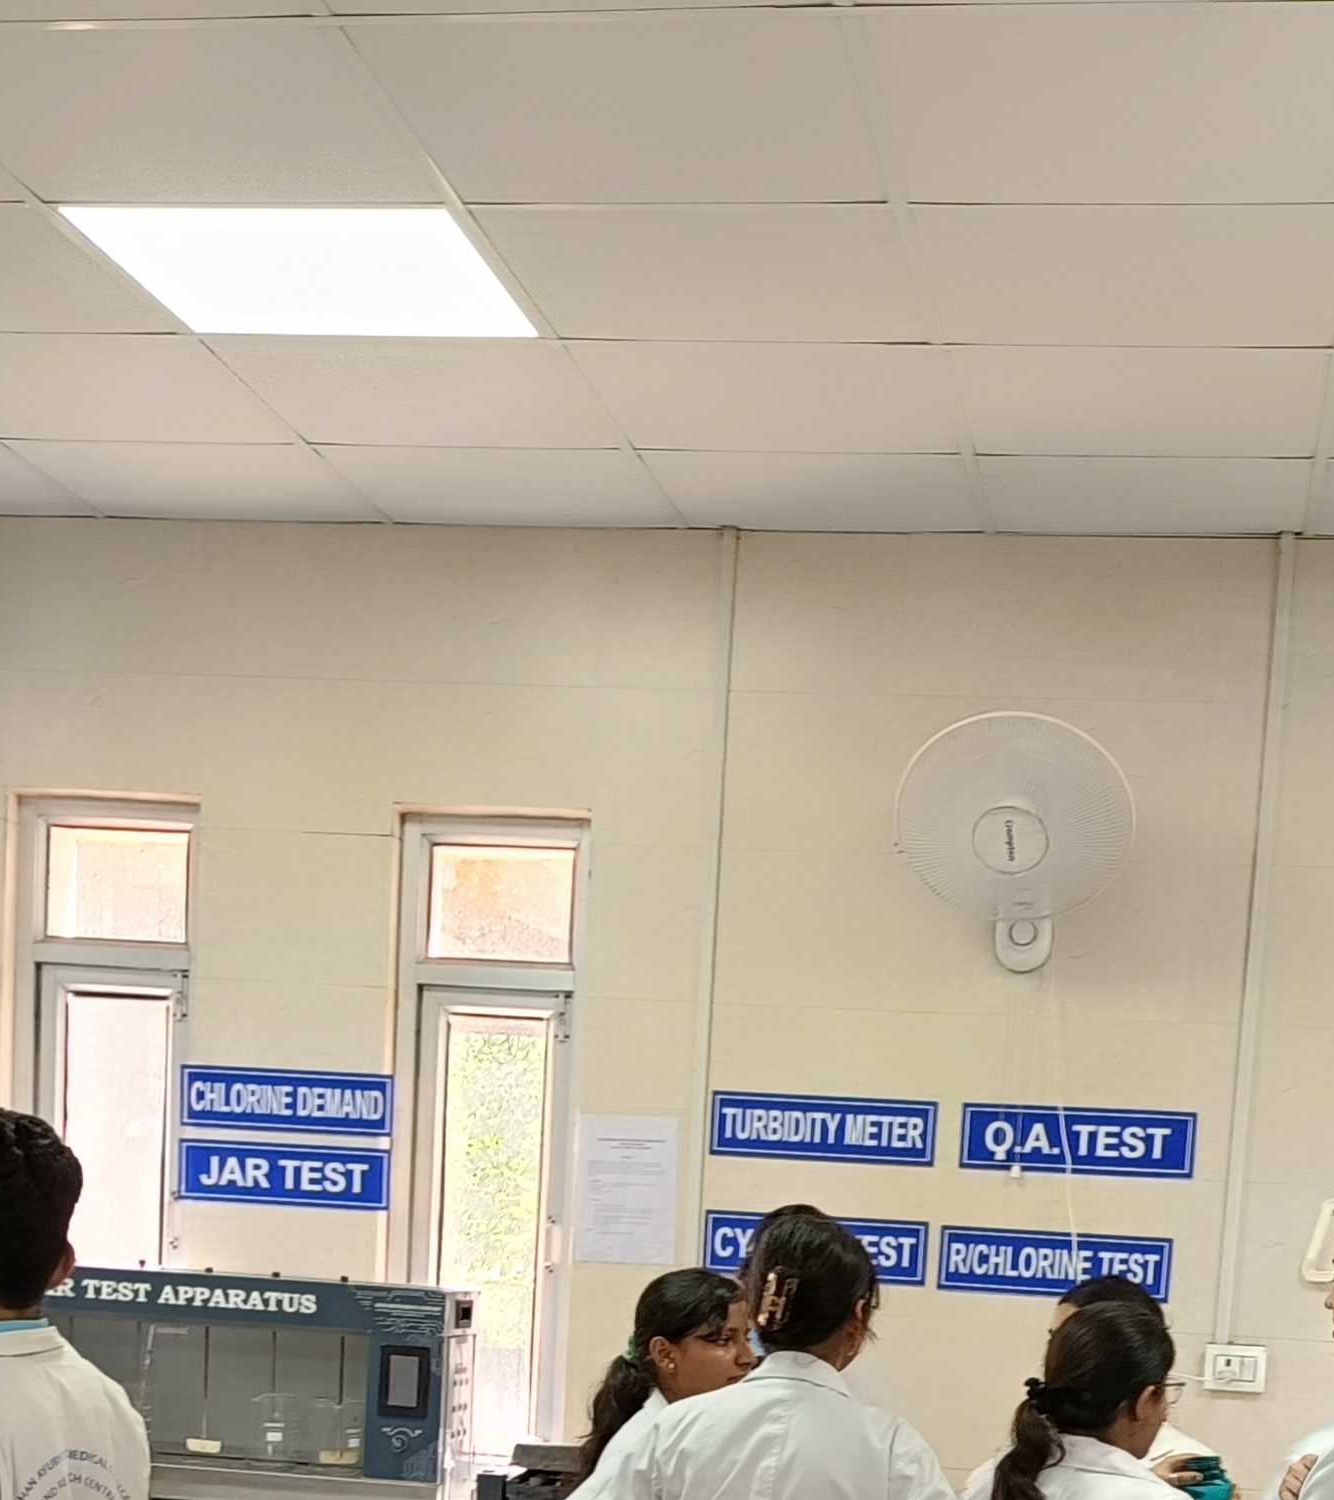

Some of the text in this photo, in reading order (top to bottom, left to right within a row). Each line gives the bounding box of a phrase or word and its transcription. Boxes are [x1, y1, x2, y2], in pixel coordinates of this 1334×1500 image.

[190, 1081, 385, 1121] CHLORINE DEMAND
[721, 1107, 924, 1149] TURBIDITY METER
[1071, 1124, 1172, 1159] TEST
[199, 1155, 370, 1194] JAR TEST
[855, 1235, 917, 1268] EST
[81, 1279, 152, 1303] TEST
[157, 1285, 318, 1314] APPARATUS
